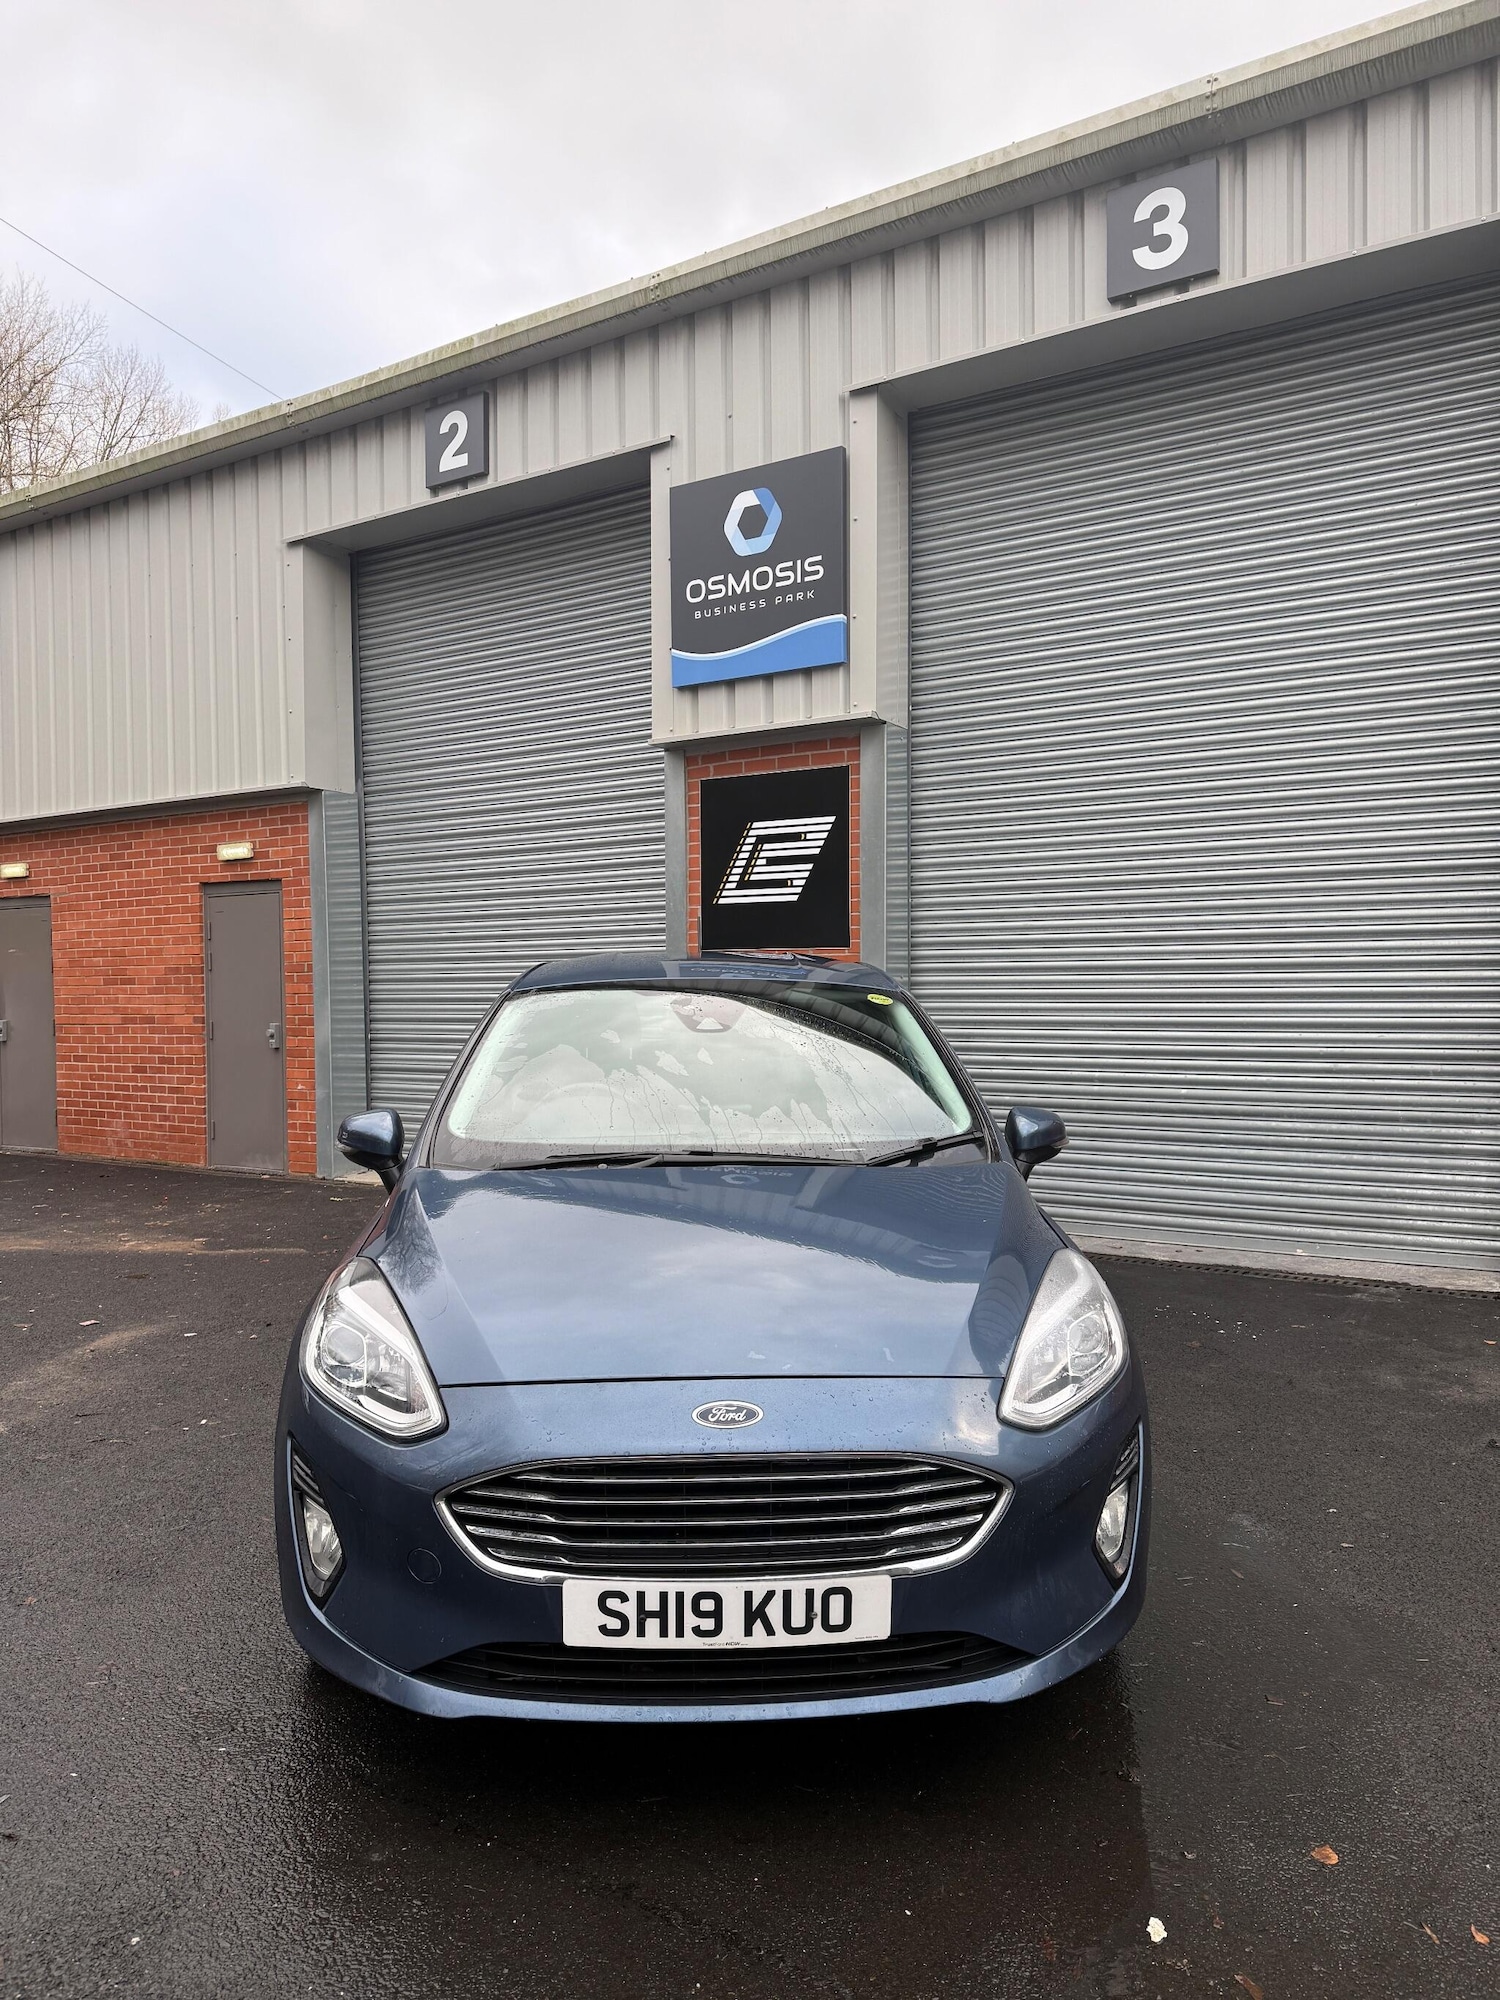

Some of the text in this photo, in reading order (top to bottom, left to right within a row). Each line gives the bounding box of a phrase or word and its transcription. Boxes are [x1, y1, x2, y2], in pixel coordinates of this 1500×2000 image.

[1132, 186, 1189, 271] 3
[439, 410, 469, 473] 2
[686, 555, 825, 604] OSMOSIS
[694, 589, 815, 619] BUSINESS PARK
[708, 1406, 747, 1422] Ford
[597, 1586, 853, 1638] SH19 KUO
